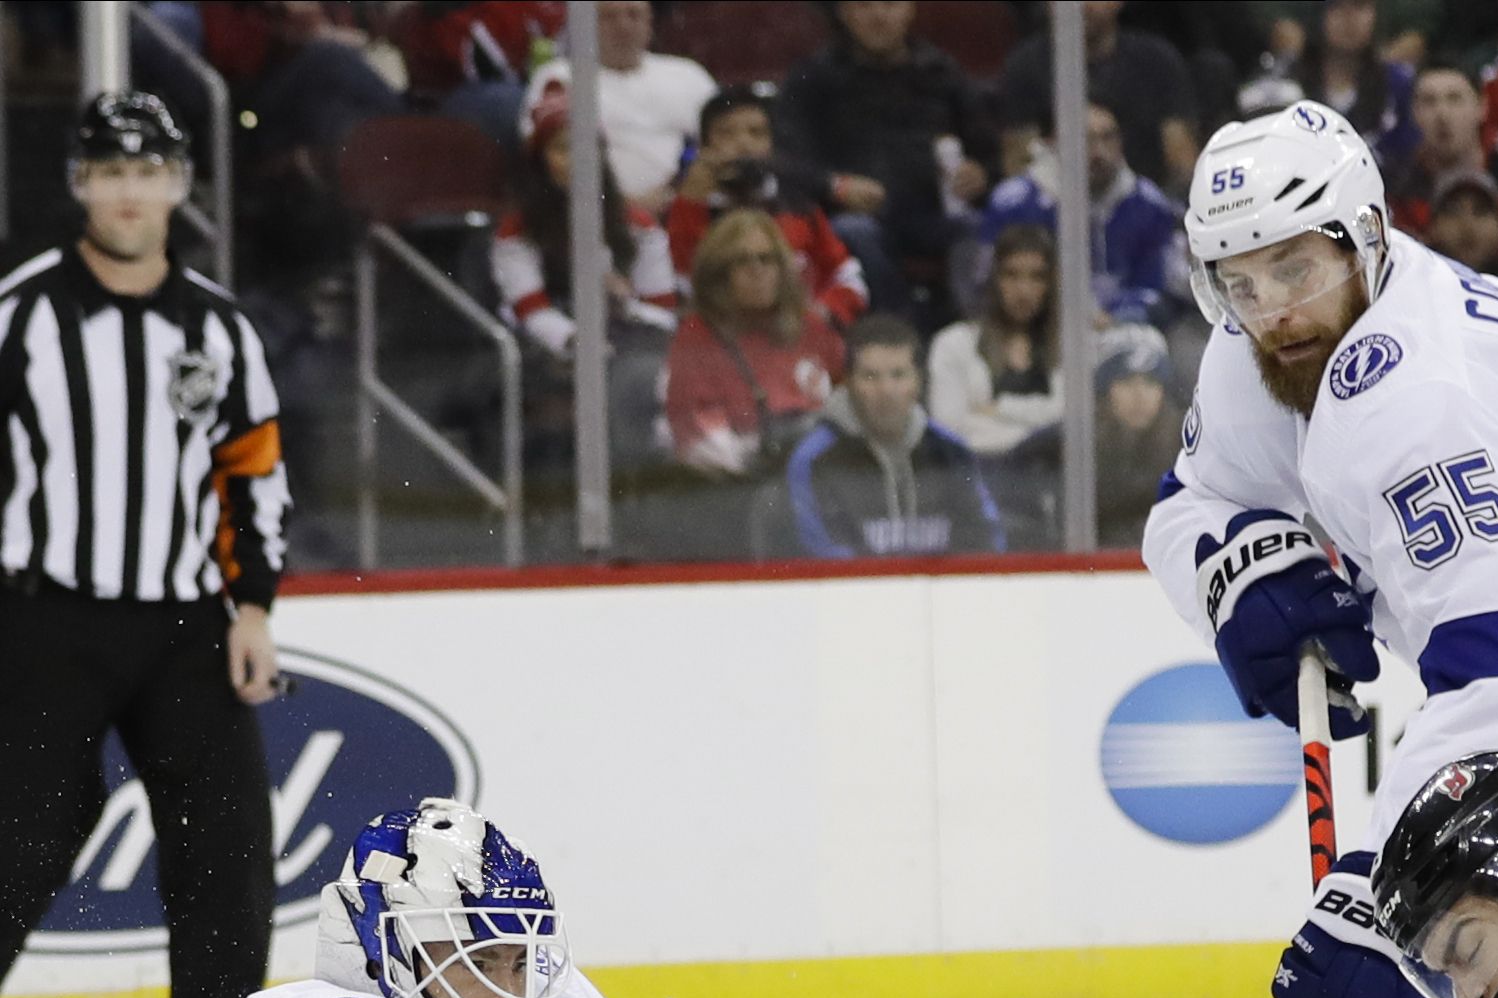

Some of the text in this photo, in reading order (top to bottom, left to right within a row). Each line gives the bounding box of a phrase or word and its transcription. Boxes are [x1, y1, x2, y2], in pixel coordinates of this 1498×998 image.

[1212, 167, 1244, 194] 55
[491, 887, 549, 900] CCM
[1379, 890, 1402, 927] CCM
